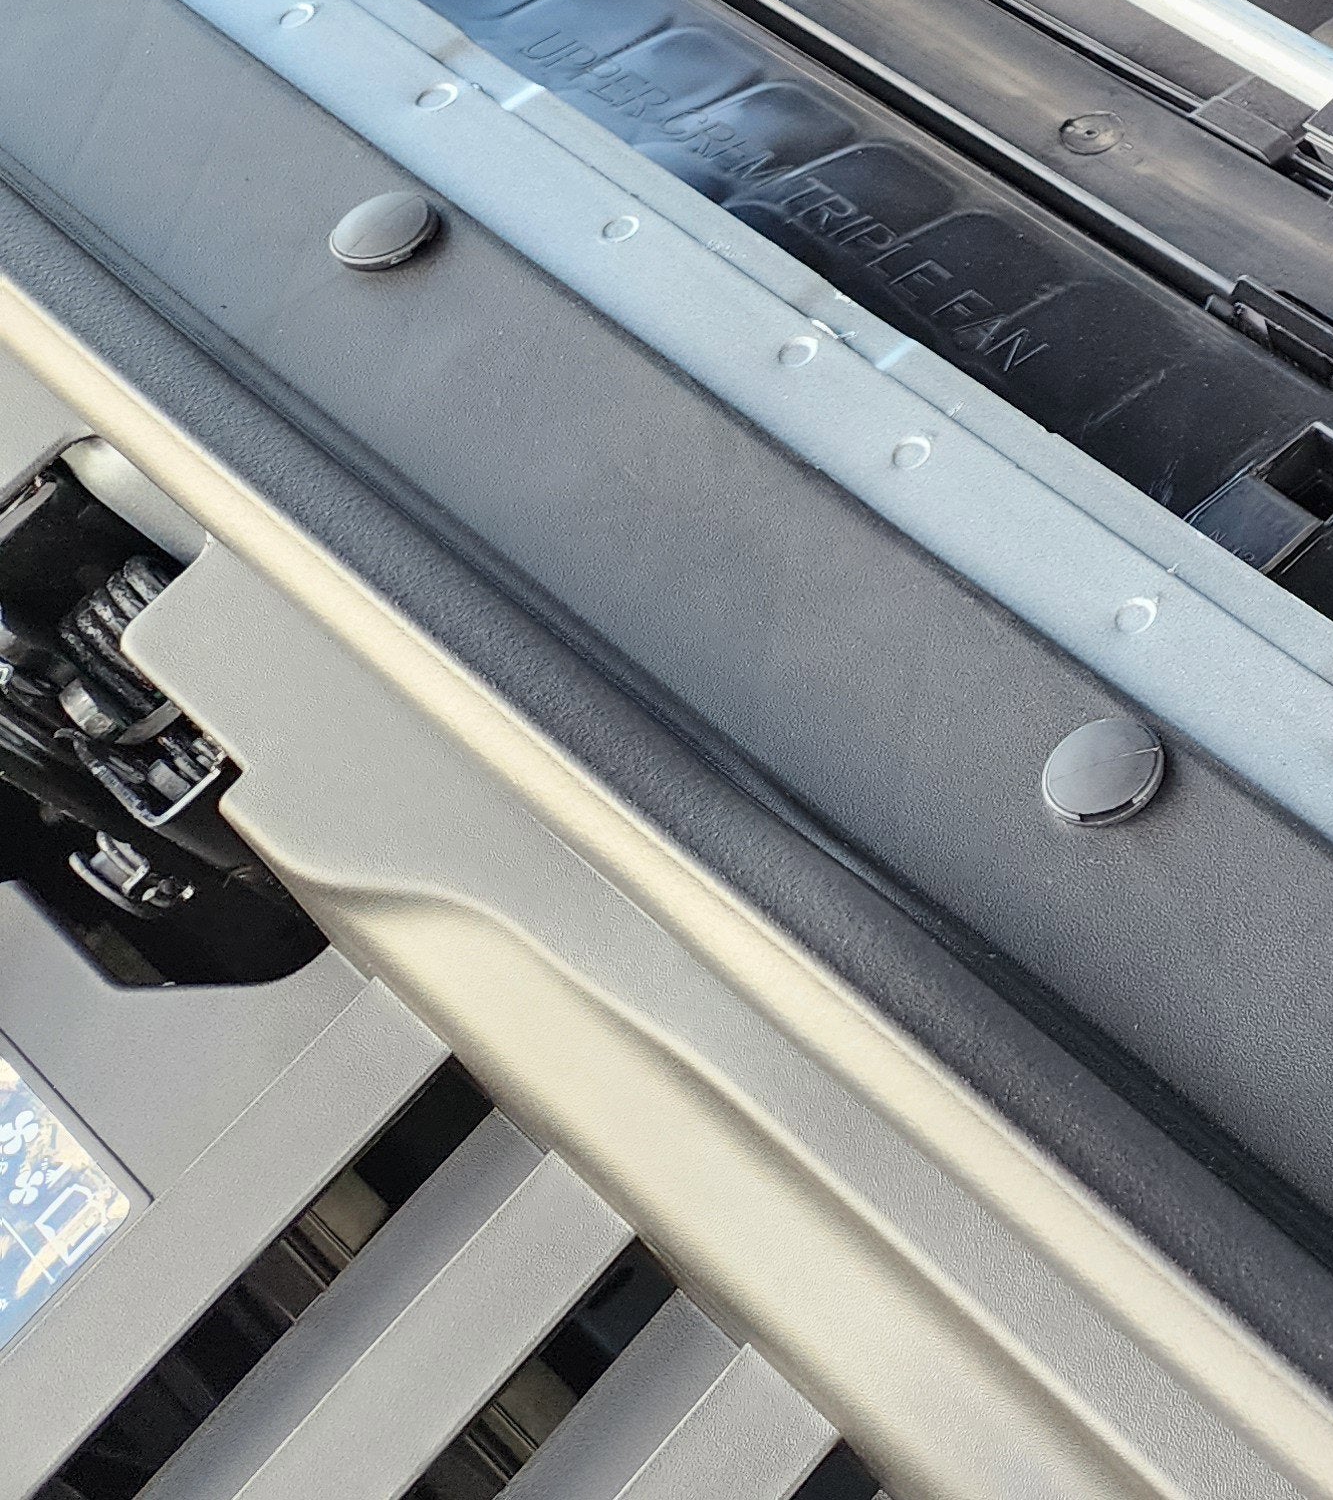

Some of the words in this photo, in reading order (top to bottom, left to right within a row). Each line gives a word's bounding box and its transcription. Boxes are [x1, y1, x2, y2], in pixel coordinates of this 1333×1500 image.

[520, 25, 675, 123] UPPER
[778, 176, 951, 301] TRIPLE
[934, 285, 1051, 373] FAN
